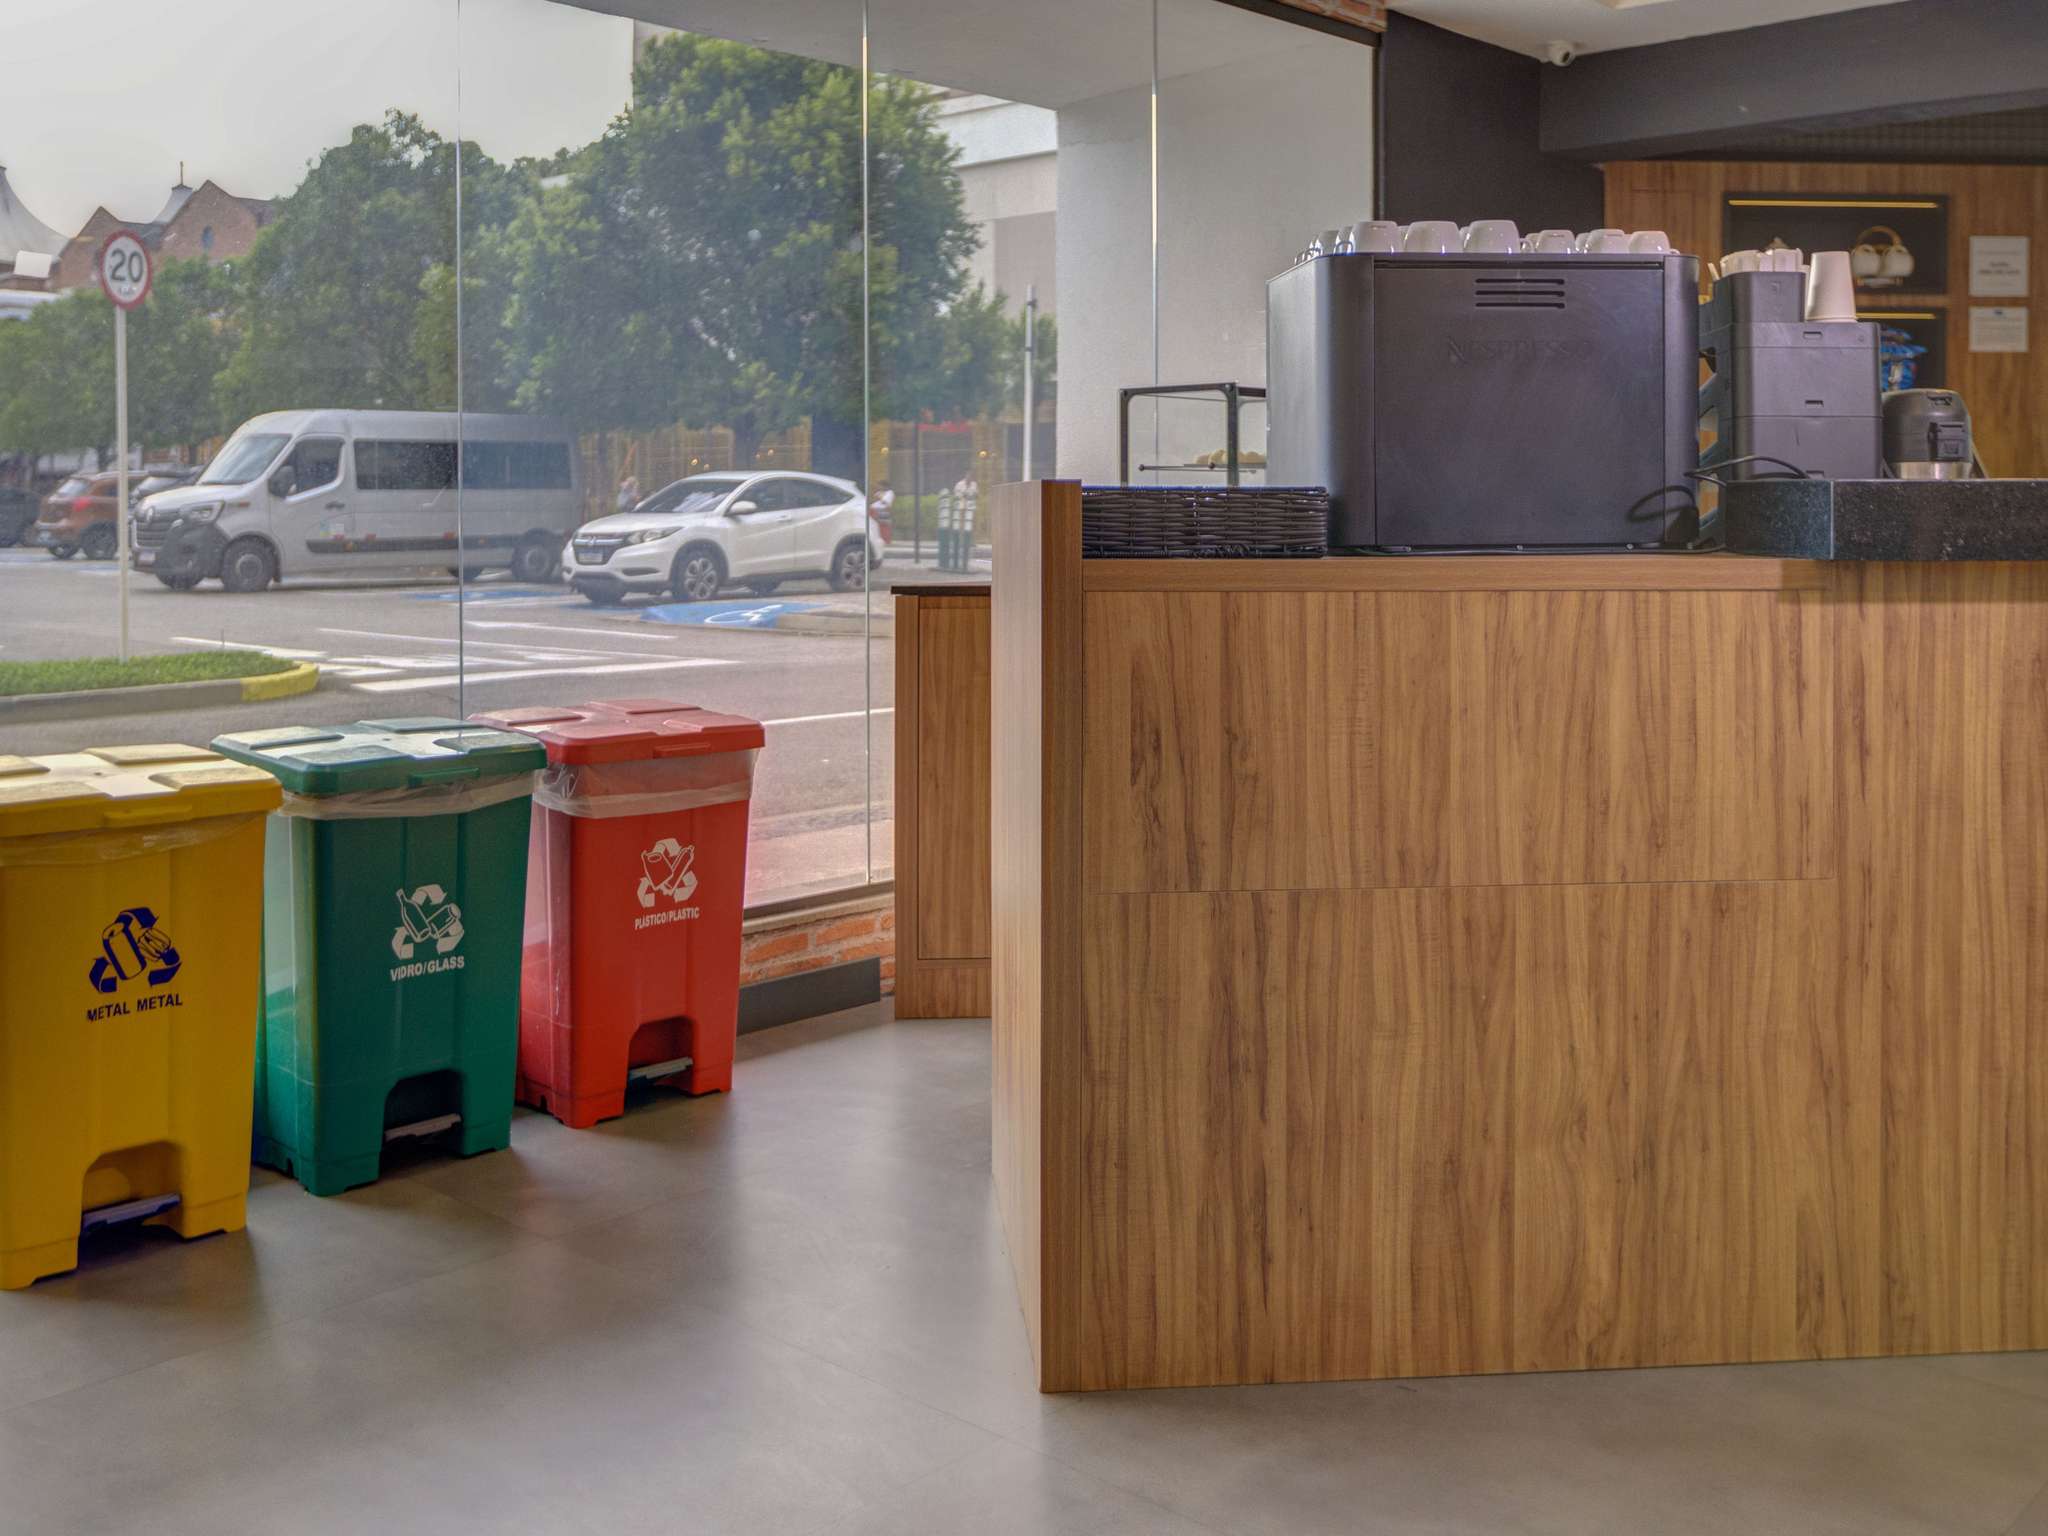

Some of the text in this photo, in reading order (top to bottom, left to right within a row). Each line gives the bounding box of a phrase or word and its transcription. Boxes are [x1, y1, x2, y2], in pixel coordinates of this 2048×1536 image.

[111, 248, 144, 283] 20
[390, 955, 465, 982] VIDRO/GLASS
[87, 993, 182, 1022] METAL METAL
